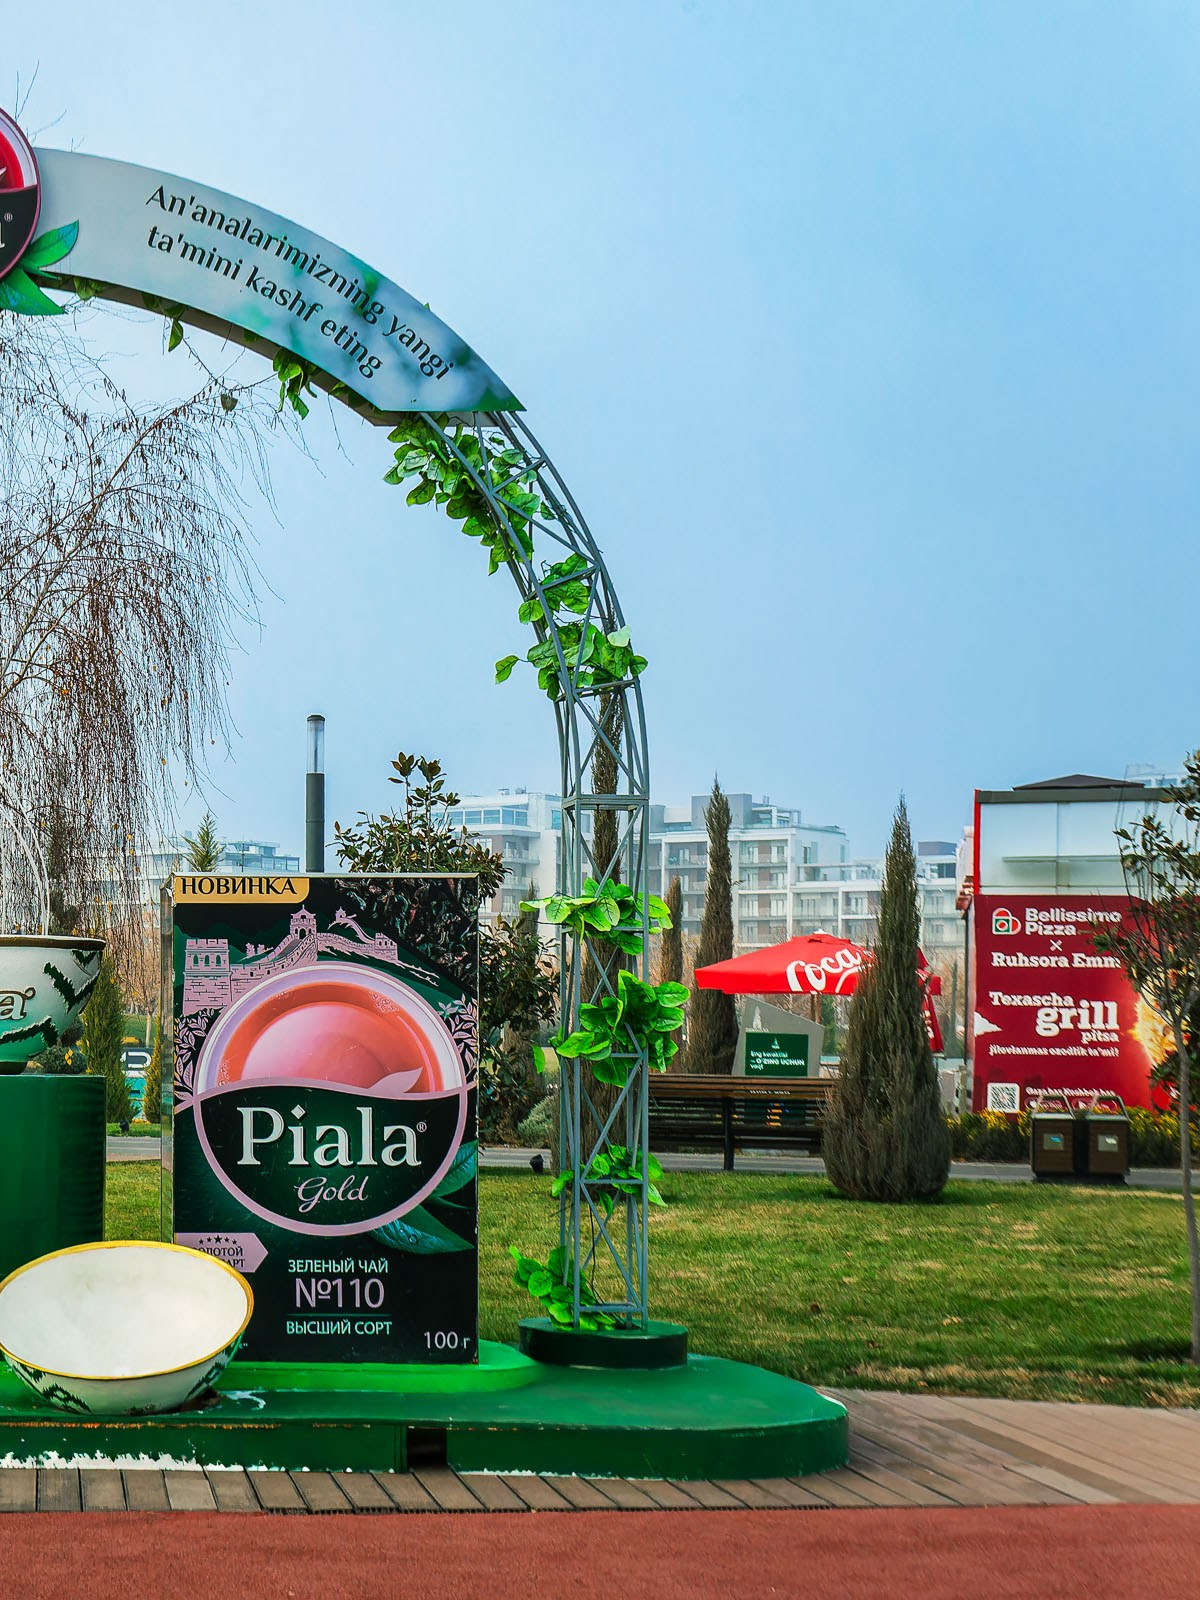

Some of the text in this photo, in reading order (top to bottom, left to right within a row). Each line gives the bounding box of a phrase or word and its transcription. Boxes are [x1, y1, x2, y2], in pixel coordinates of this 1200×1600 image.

[145, 185, 454, 381] An'analarimizning yangi
[147, 225, 383, 379] ta'mini kashf eting
[180, 877, 297, 895] НОВИНКА
[1025, 908, 1122, 922] Bellissimo
[1025, 921, 1076, 935] Pizza
[991, 952, 1070, 968] Ruhsora
[989, 991, 1074, 1007] Texascha
[1035, 999, 1120, 1037] grill
[1081, 1030, 1120, 1044] pitsa
[295, 1175, 368, 1213] Gold
[193, 1246, 243, 1256] ЛОТОЙ
[288, 1258, 389, 1273] ЗЕЛЕНЫЙ ЧАЙ
[295, 1278, 385, 1308] №110
[286, 1320, 393, 1335] ВЫСШИЙ СОРТ
[423, 1331, 458, 1350] 100
